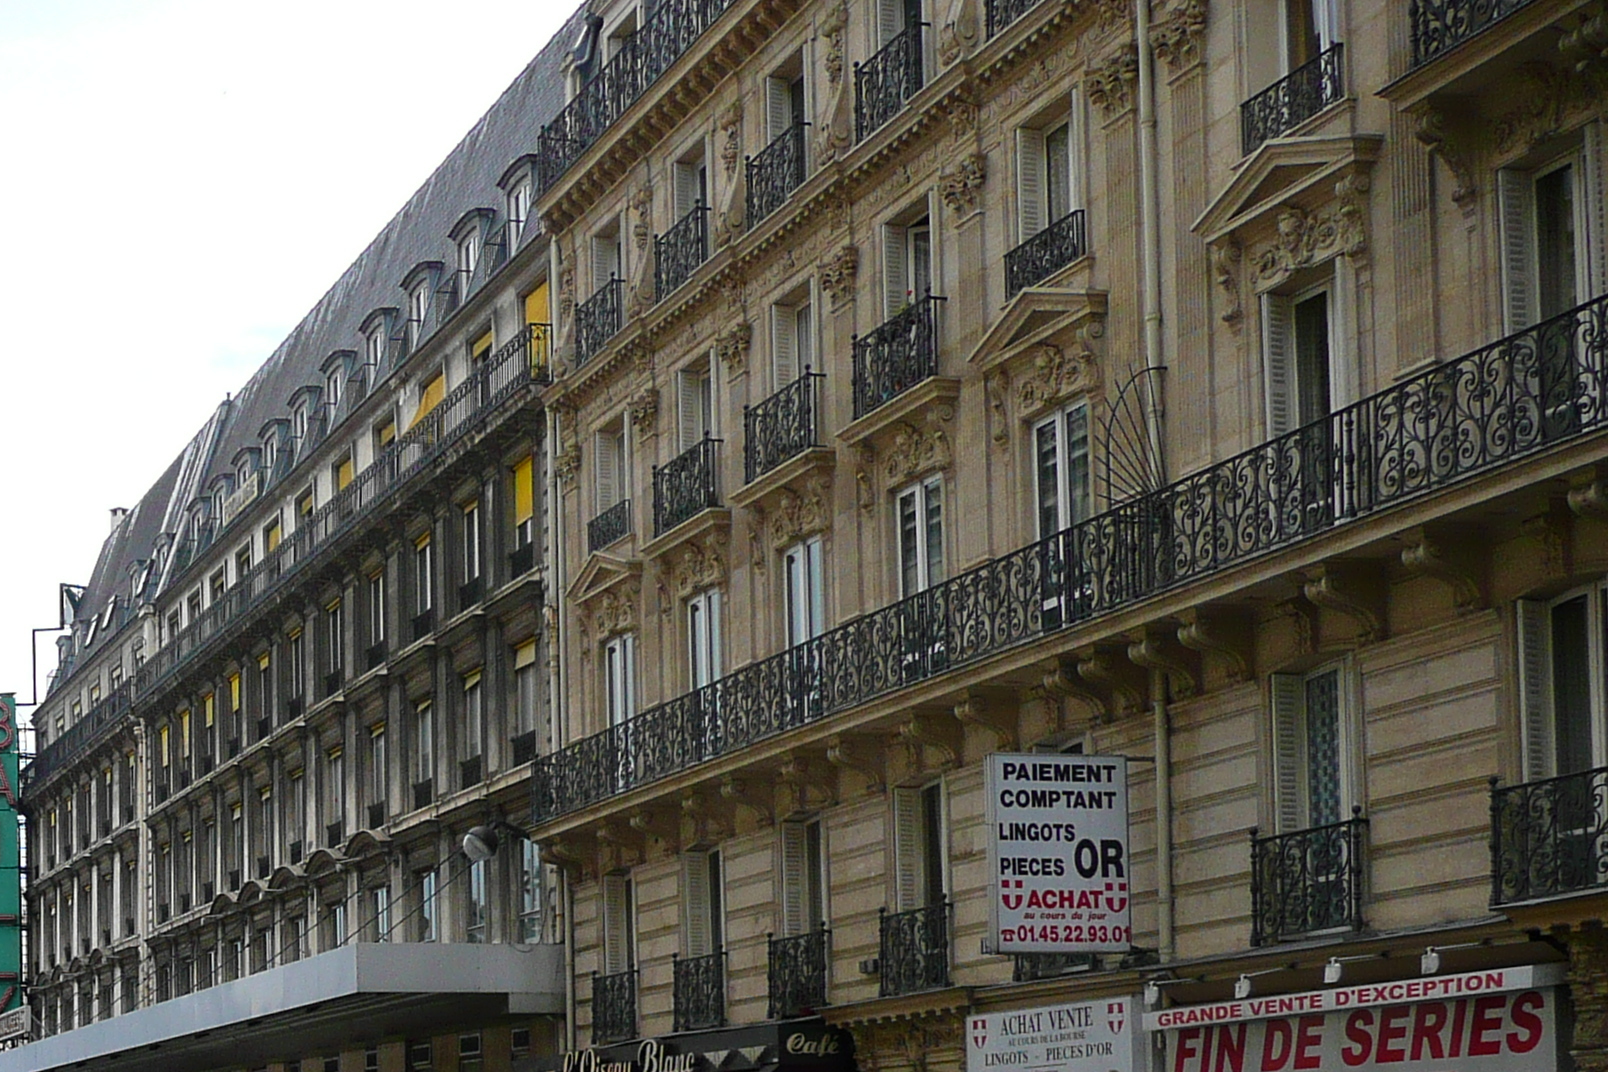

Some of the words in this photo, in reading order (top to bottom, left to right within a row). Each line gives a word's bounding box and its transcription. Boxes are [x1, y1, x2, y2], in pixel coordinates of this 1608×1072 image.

[1003, 763, 1116, 782] PAIEMENT
[1000, 789, 1116, 809] COMPTANT
[999, 823, 1075, 841] LINGOTS
[1000, 857, 1065, 876] PIECES
[1074, 838, 1124, 878] OR
[1026, 890, 1104, 909] ACHAT
[1024, 912, 1035, 920] au
[1040, 912, 1066, 920] cours
[1071, 911, 1083, 920] du
[1088, 911, 1107, 922] jour
[1017, 925, 1132, 943] 01.45.22.93.01
[1158, 1005, 1242, 1027] GRANDE
[1249, 993, 1323, 1014] VENTE
[1335, 972, 1504, 1007] D'EXCEPTION
[1000, 1013, 1043, 1036] ACHAT
[1048, 1006, 1094, 1030] VENTE
[1260, 1014, 1325, 1072] DE
[1341, 990, 1545, 1067] SERIES
[786, 1032, 839, 1057] Café
[984, 1051, 1028, 1067] LINGOTS
[1046, 1045, 1083, 1062] PIECES
[1085, 1042, 1113, 1058] D'OR
